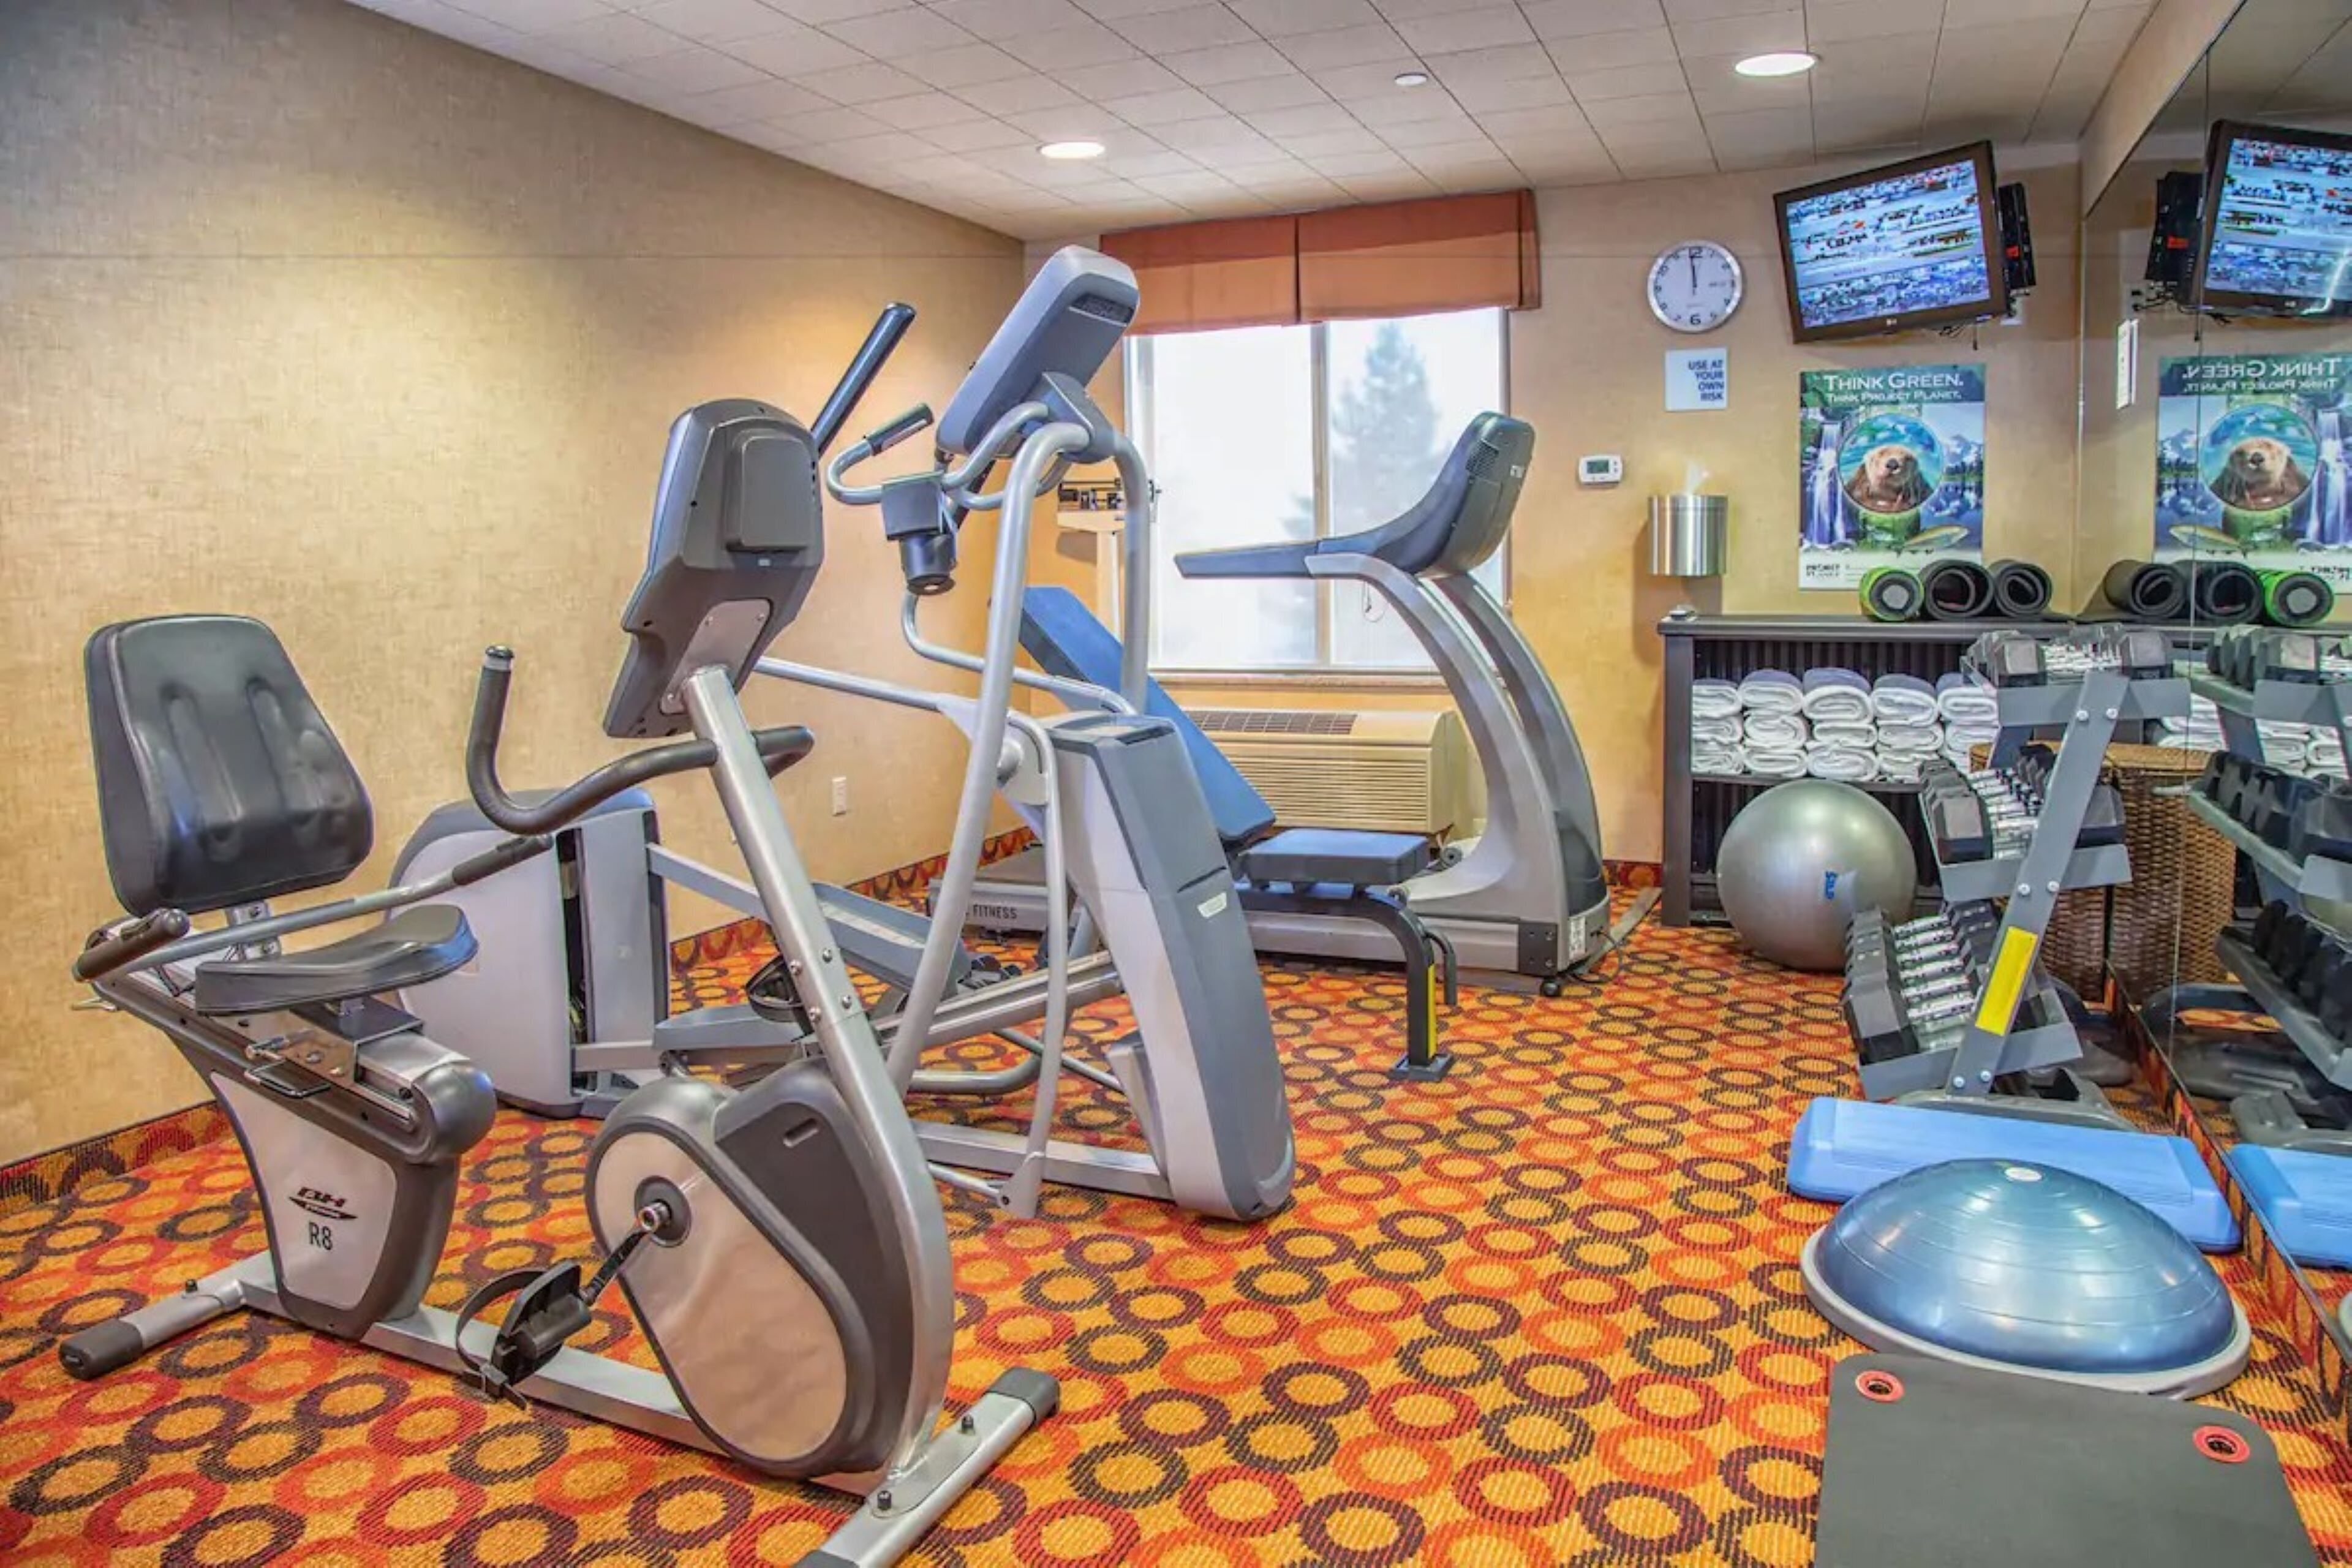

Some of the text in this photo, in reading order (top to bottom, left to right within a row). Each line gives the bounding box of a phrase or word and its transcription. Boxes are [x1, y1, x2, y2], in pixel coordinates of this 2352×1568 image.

[1690, 313, 1702, 325] 6
[1688, 359, 1724, 371] USE AT
[1694, 371, 1724, 380] YOUR
[1823, 372, 1964, 391] THINK GREEN.
[1698, 380, 1725, 391] OWN
[1700, 391, 1724, 402] RISK
[1861, 391, 1910, 402] PROJECT
[973, 903, 1018, 919] FITNESS
[308, 1221, 333, 1251] R8
